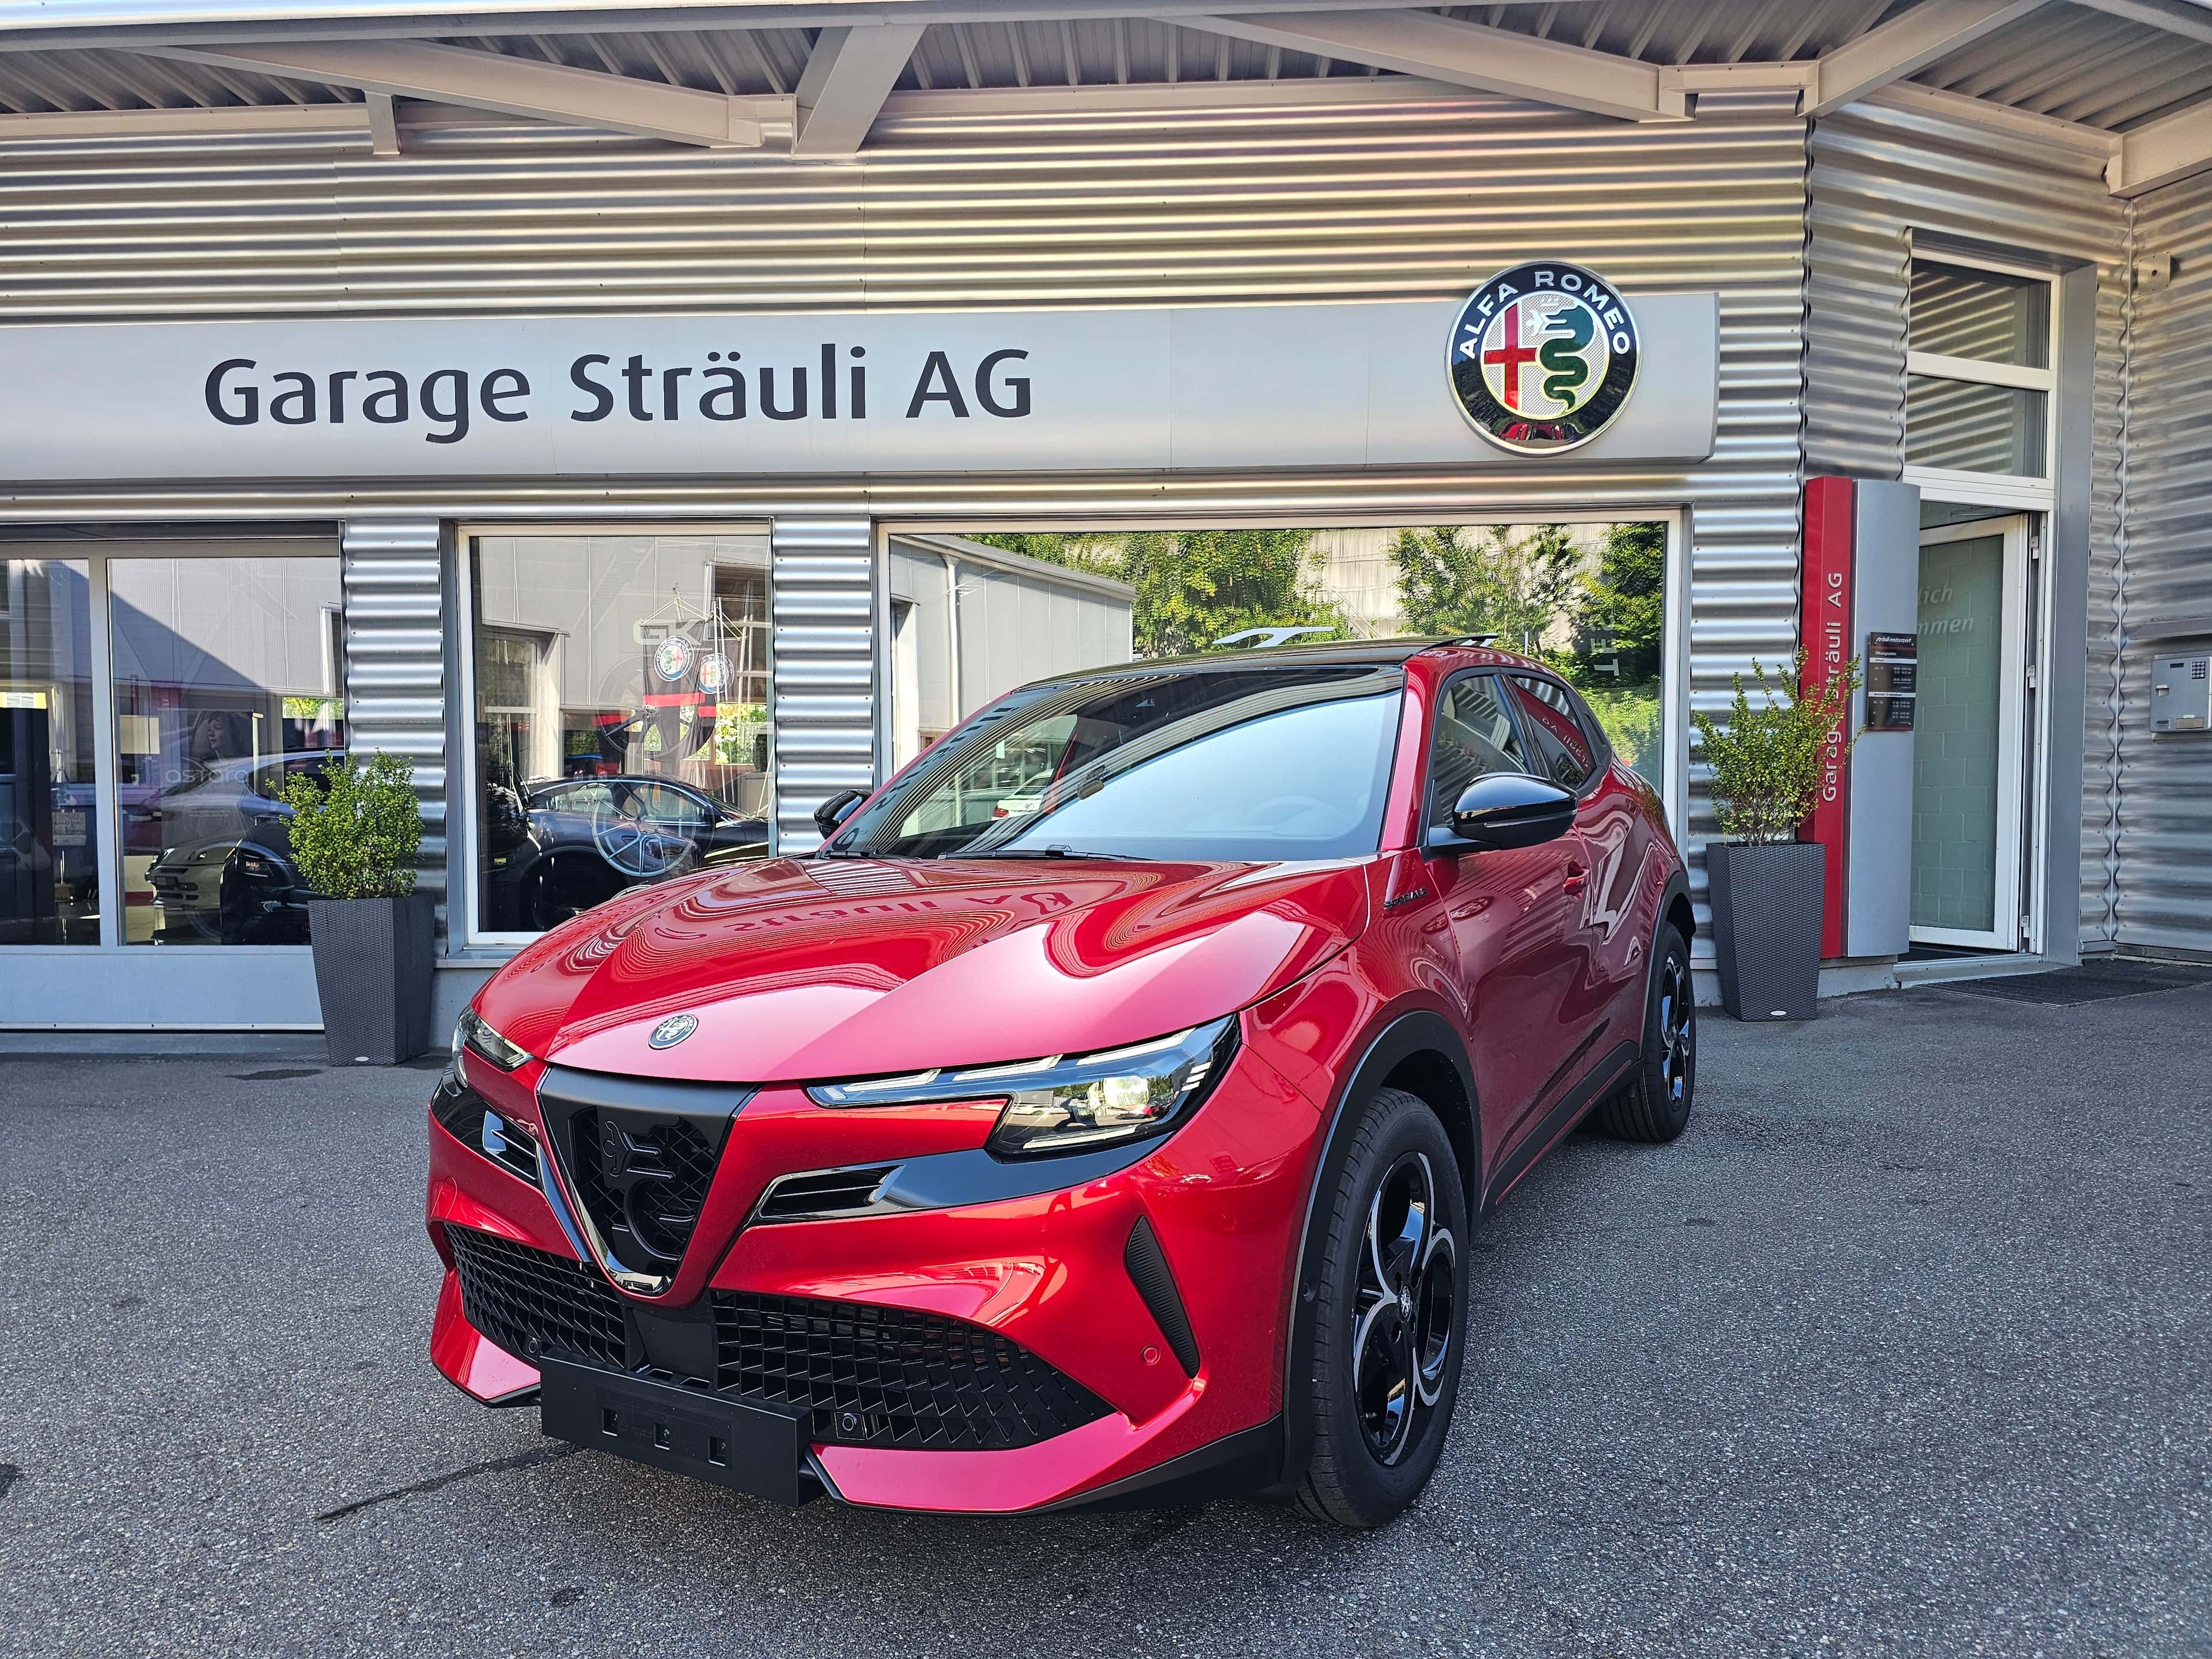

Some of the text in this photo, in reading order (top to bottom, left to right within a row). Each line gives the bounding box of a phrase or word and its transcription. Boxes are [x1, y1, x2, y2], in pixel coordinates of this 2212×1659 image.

[1459, 271, 1630, 359] ALFA ROMEO
[204, 343, 1031, 444] Garage Sträuli AG
[1828, 572, 1843, 608] AG
[1918, 581, 1953, 605] lich
[1916, 617, 1975, 636] mmen
